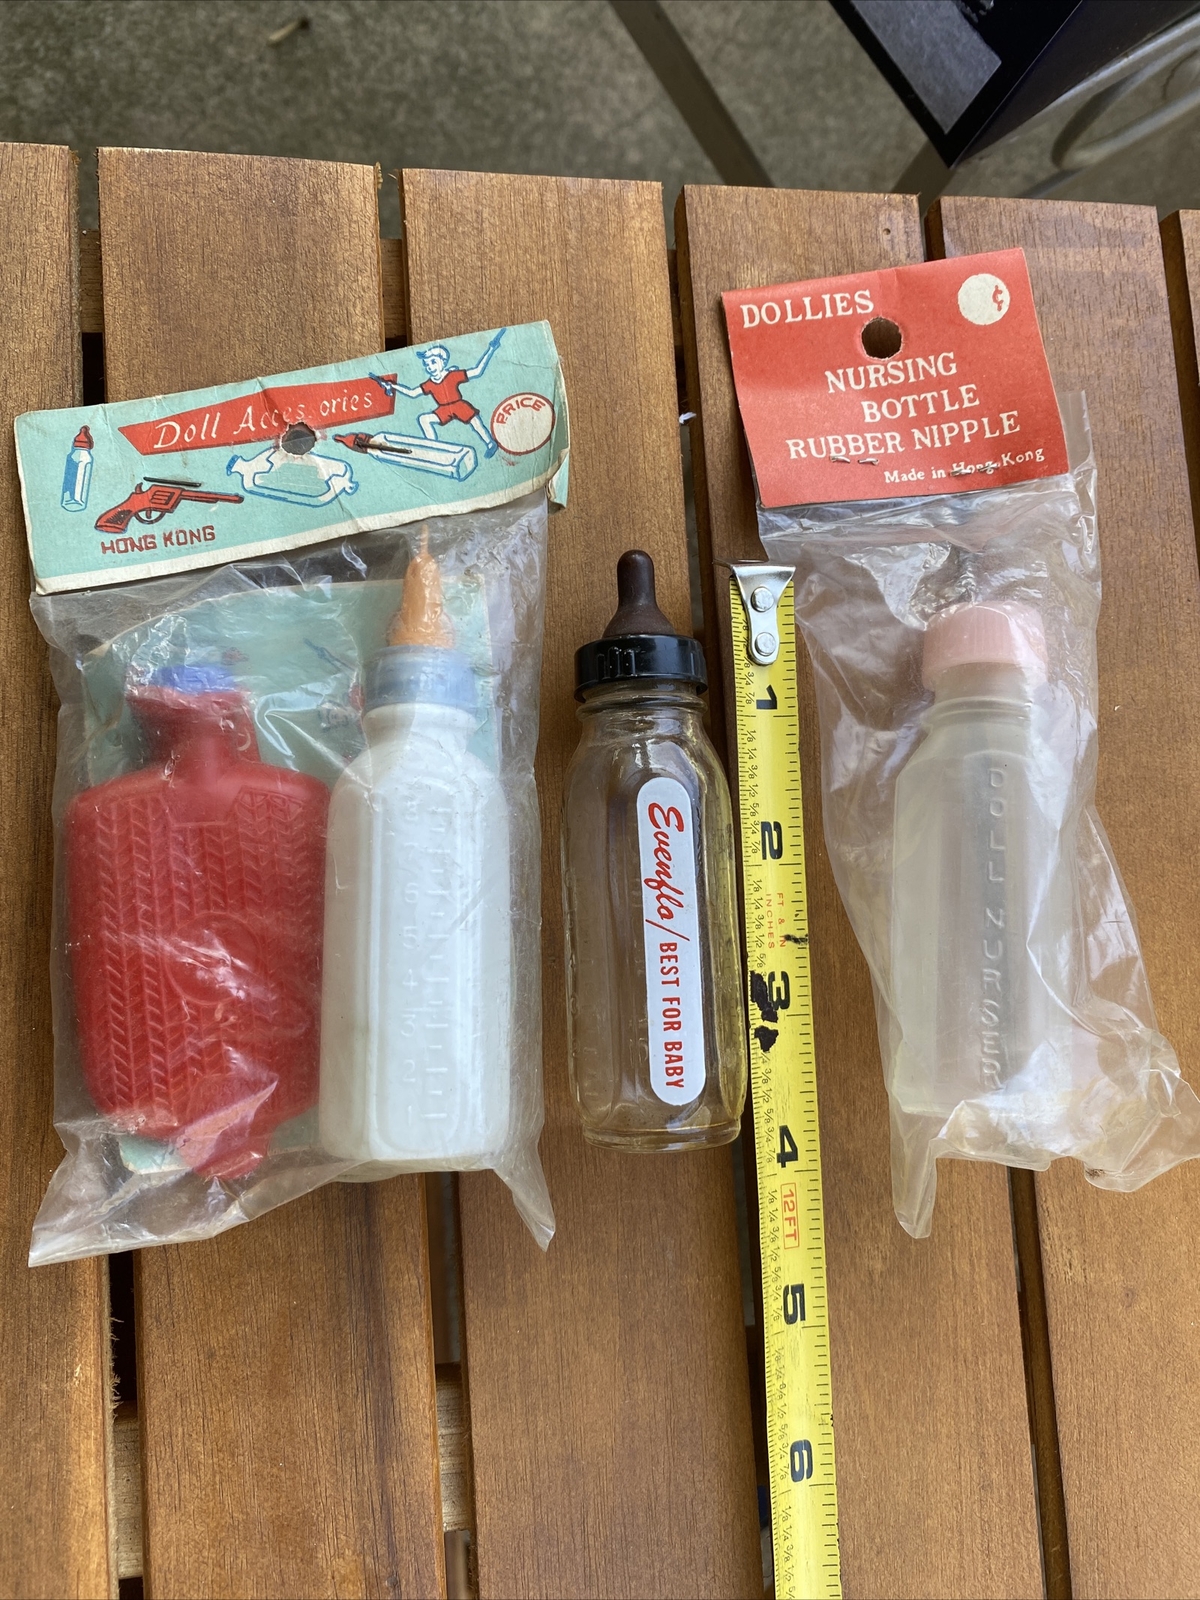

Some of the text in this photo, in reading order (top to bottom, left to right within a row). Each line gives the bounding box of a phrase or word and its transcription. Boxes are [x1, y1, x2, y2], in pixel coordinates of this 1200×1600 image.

[740, 289, 875, 329] DOLLIES
[824, 351, 958, 394] NURSING
[153, 389, 373, 449] Doll Accesories
[496, 397, 546, 424] PRICE
[861, 383, 980, 423] BOTTLE
[785, 410, 1021, 460] RUBBER NIPPLE
[883, 468, 925, 483] Made
[931, 467, 947, 479] in
[1001, 448, 1045, 467] Kong
[100, 525, 216, 555] HONG KONG
[756, 684, 778, 710] 1
[760, 821, 783, 860] 2
[766, 893, 775, 949] INCHES
[659, 942, 680, 987] BEST
[768, 971, 790, 1011] 3
[662, 997, 682, 1032] FOR
[663, 1041, 685, 1089] BABY
[776, 1124, 799, 1169] 4
[783, 1283, 806, 1325] 5
[790, 1439, 813, 1483] 6
